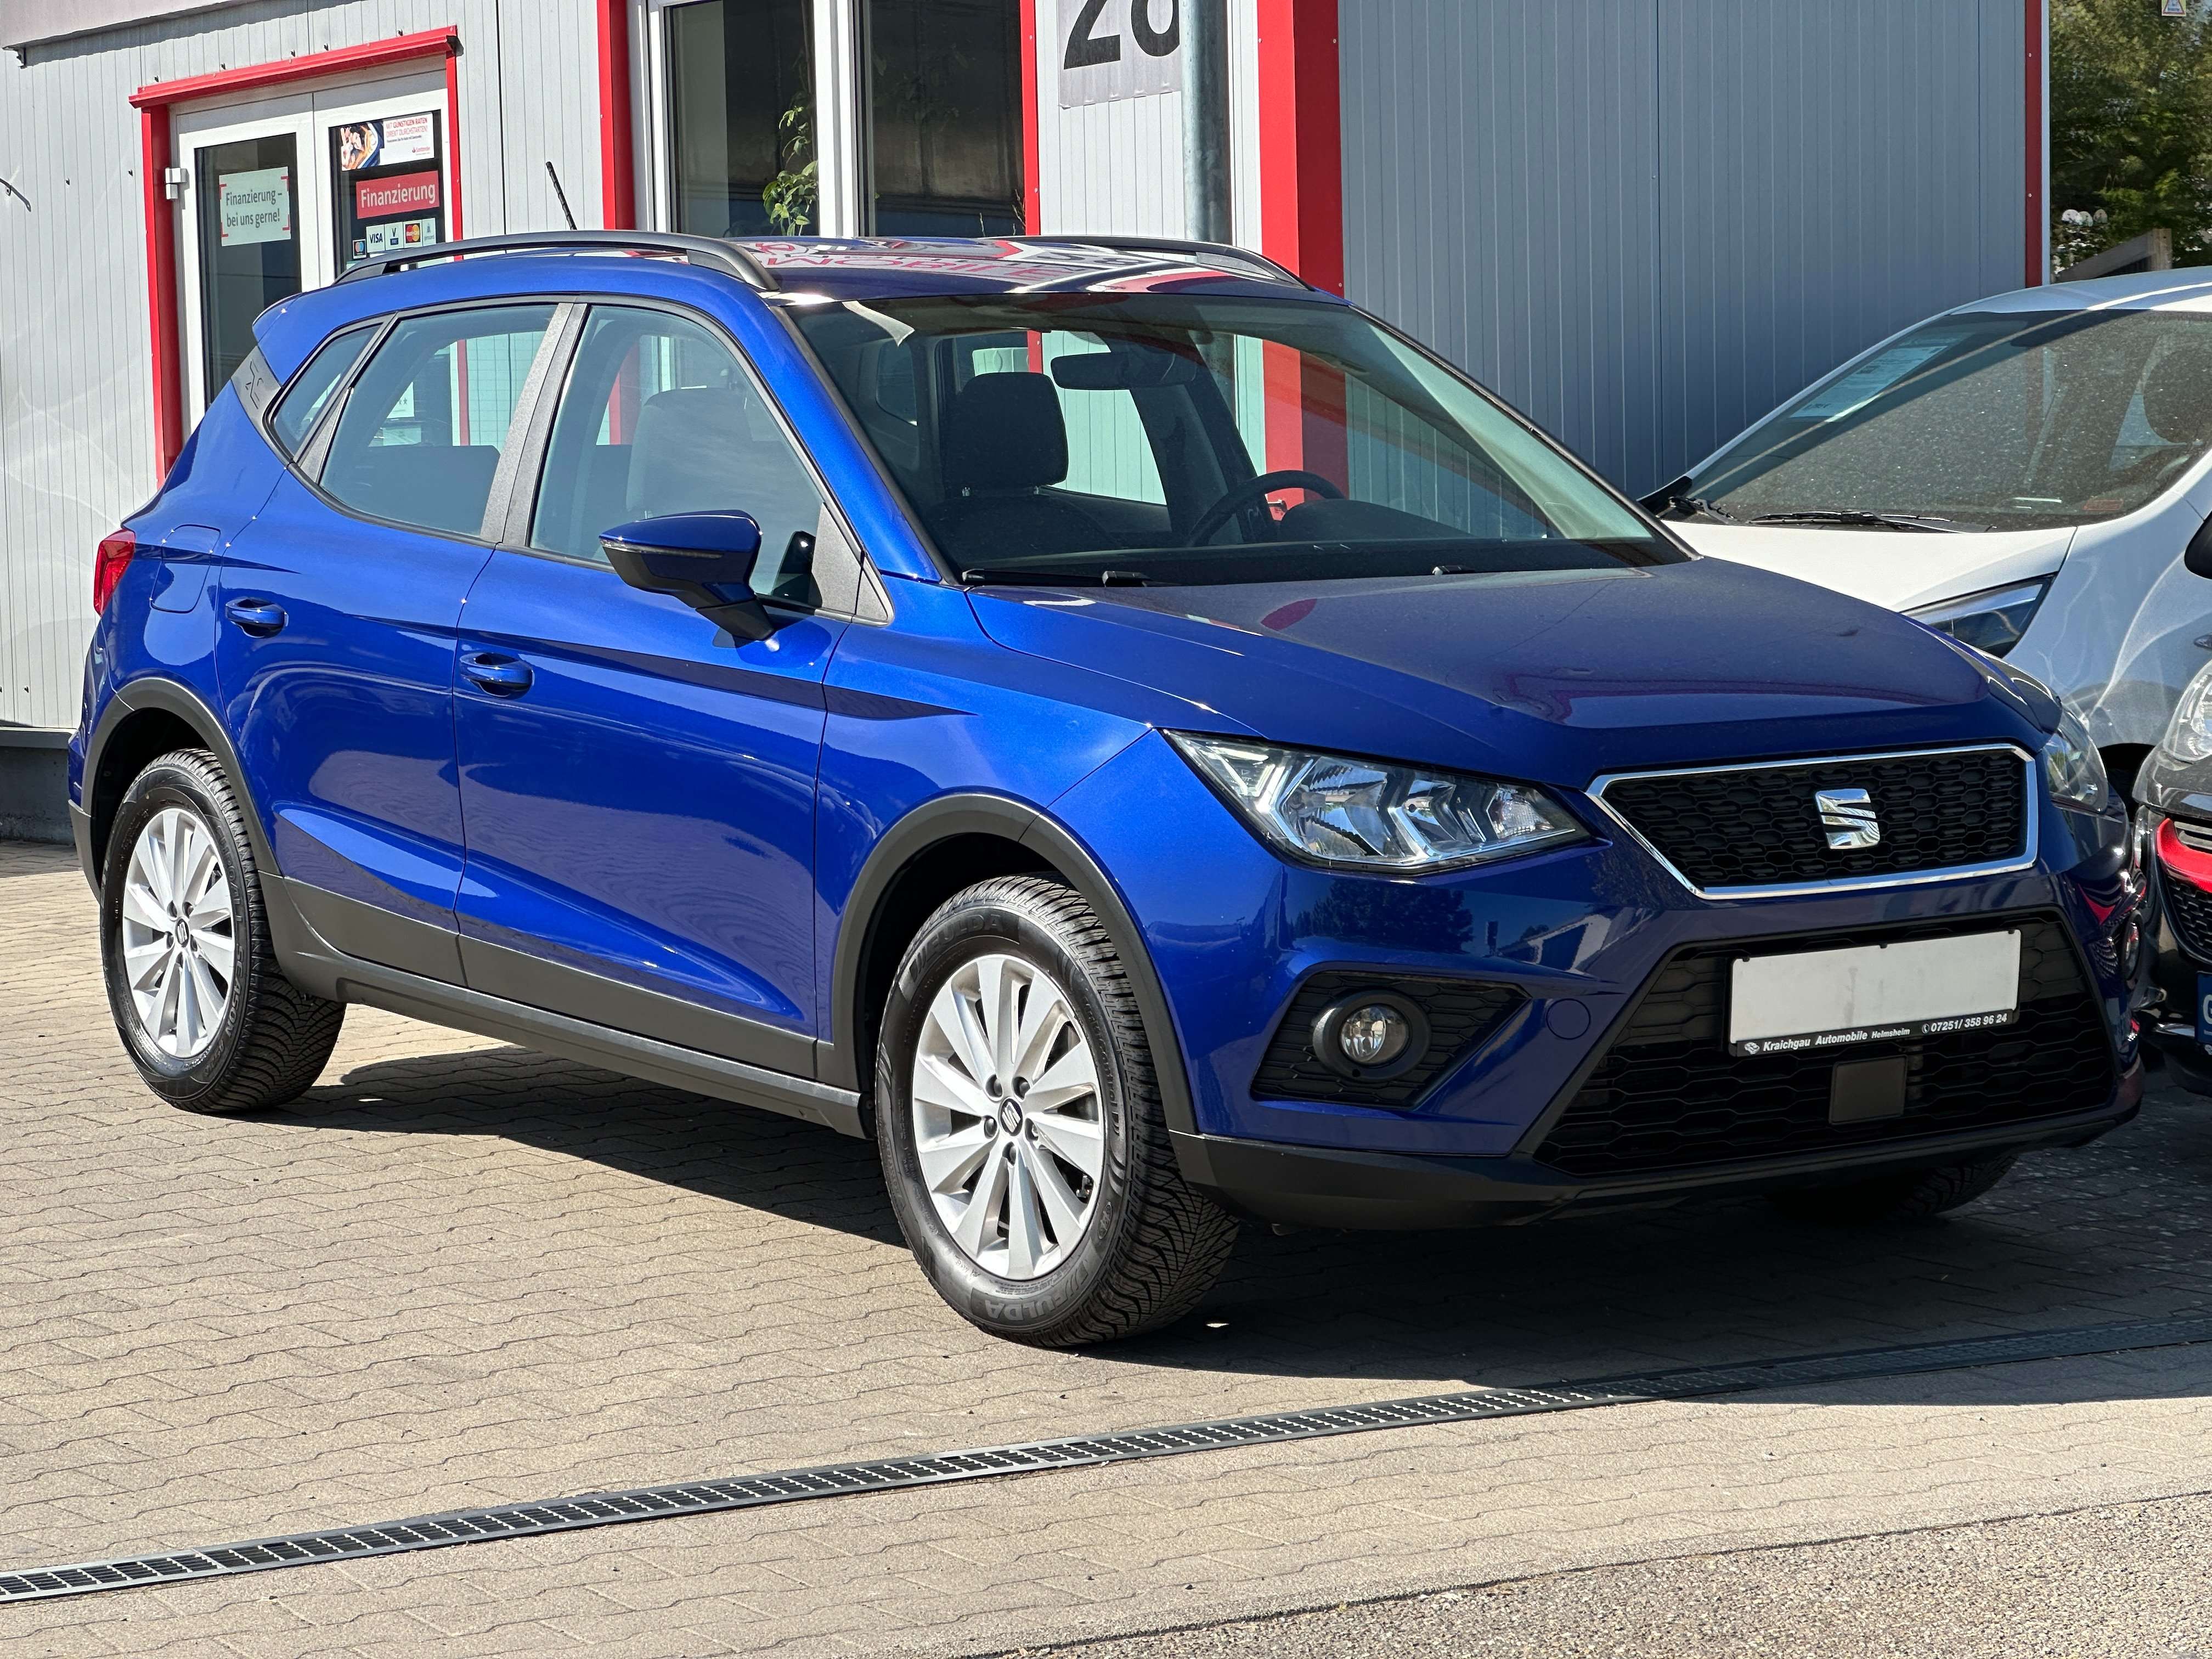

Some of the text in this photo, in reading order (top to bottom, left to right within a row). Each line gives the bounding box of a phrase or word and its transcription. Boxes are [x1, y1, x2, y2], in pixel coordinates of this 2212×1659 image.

[226, 189, 276, 206] Finanzierung
[361, 184, 436, 208] Finanzierung
[227, 208, 280, 228] bei uns gerne!
[369, 233, 383, 244] VISA
[225, 943, 244, 1038] SEASON
[1763, 1013, 2008, 1052] Kraichgau Automobile Helmsheim 07251/ 358 96 24
[985, 1283, 1070, 1322] FULDA
